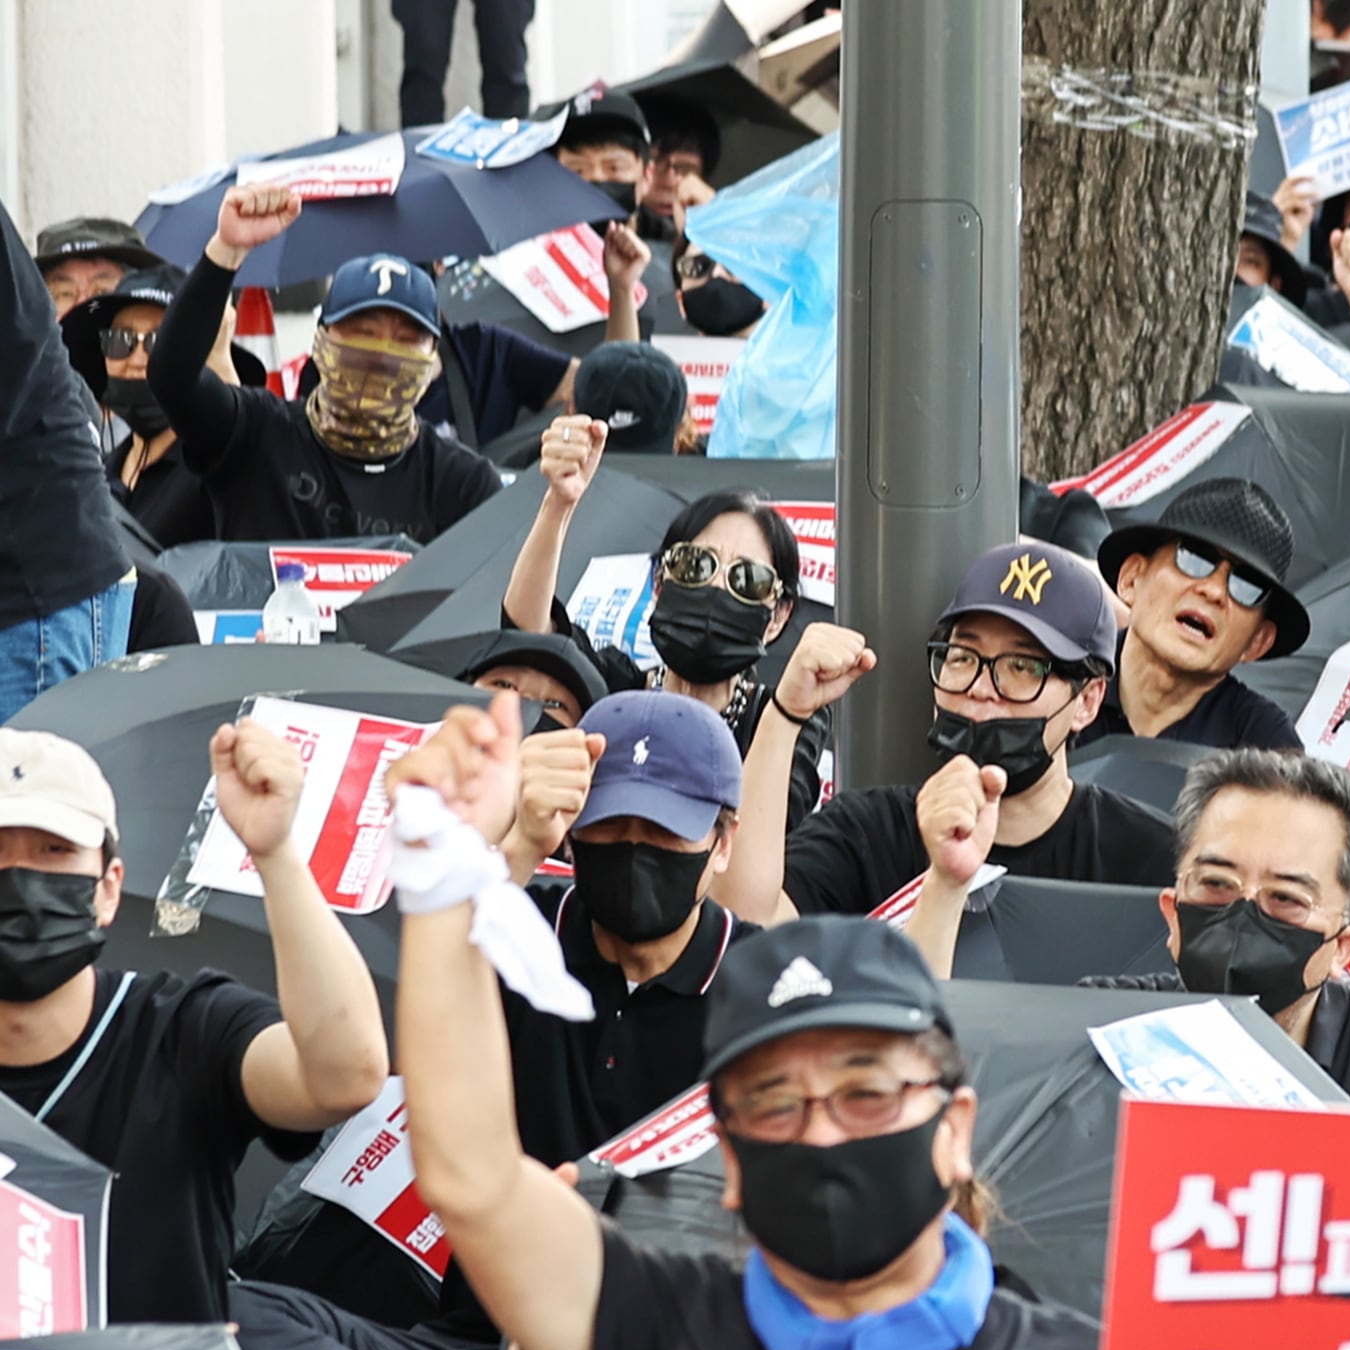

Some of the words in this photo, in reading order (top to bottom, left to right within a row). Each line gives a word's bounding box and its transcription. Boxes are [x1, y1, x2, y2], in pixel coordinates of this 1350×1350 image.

[998, 552, 1053, 607] NY
[340, 1129, 400, 1188] 구영배
[18, 1200, 54, 1338] 산몰수!
[1151, 1170, 1325, 1301] 선!
